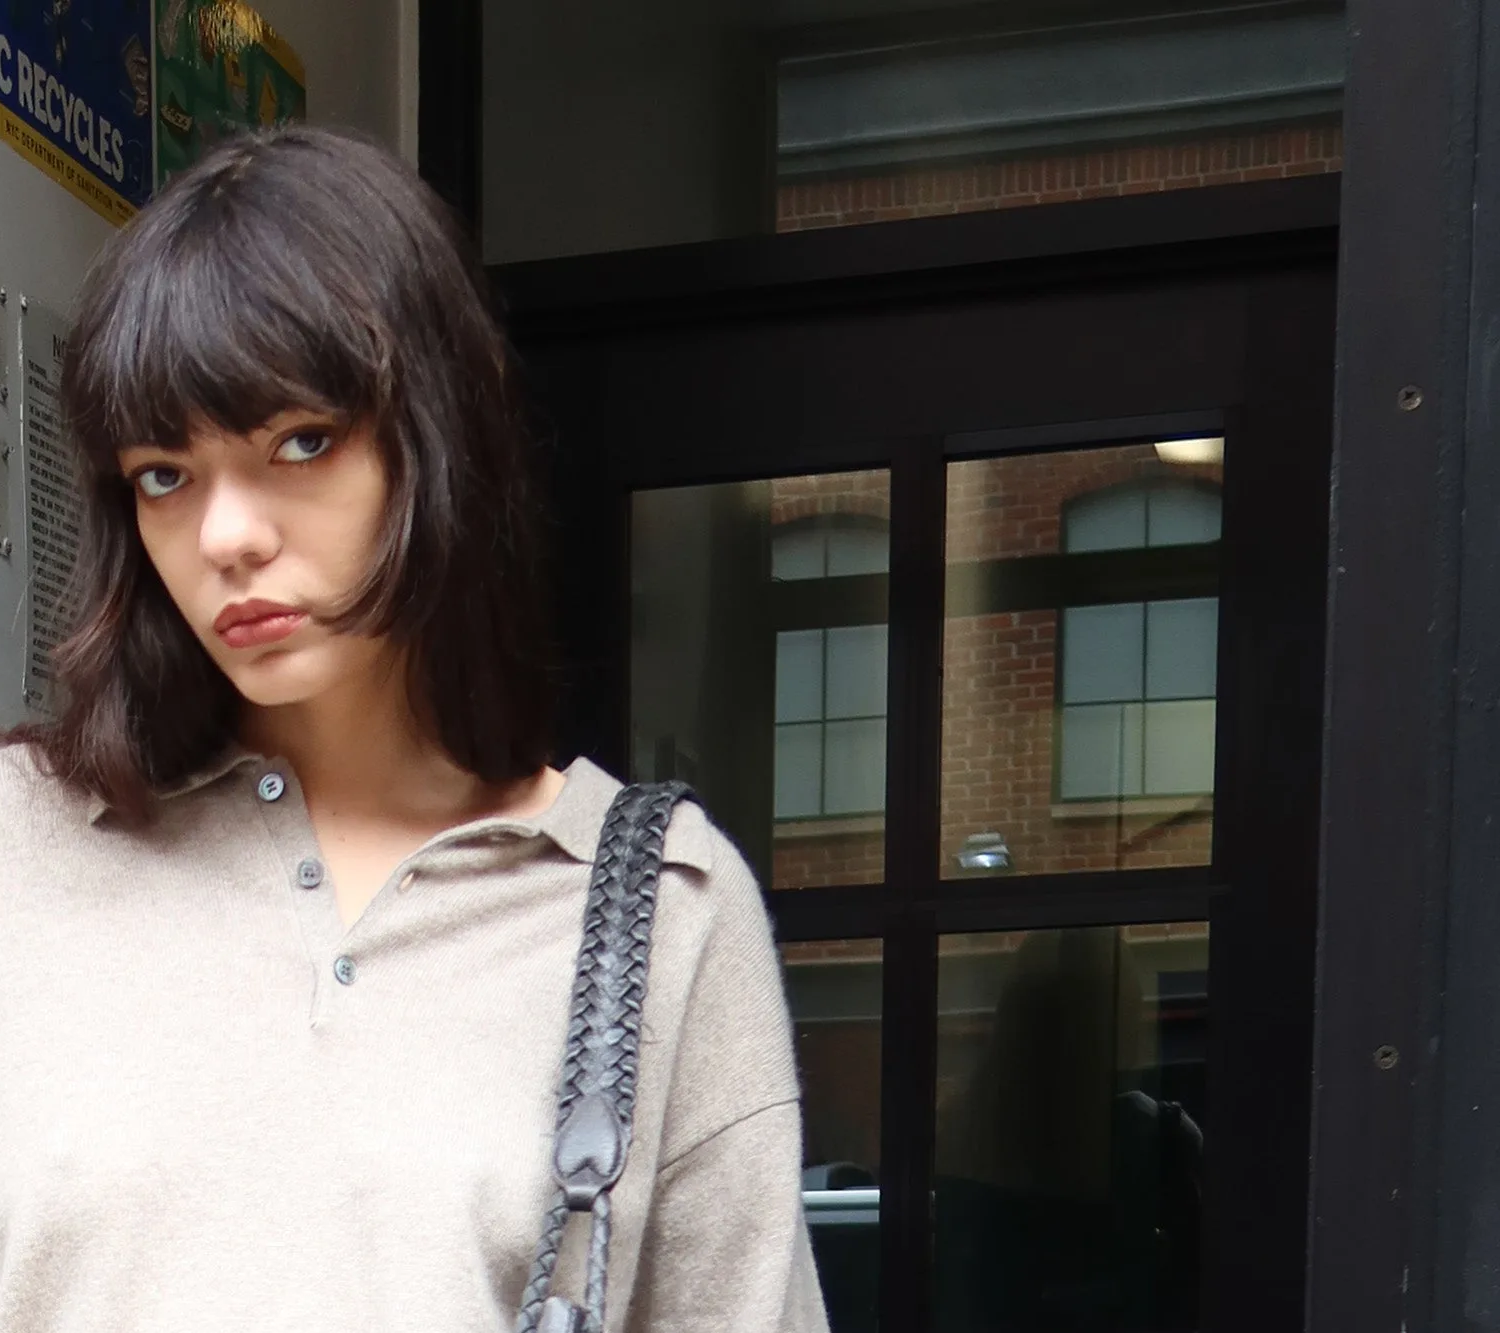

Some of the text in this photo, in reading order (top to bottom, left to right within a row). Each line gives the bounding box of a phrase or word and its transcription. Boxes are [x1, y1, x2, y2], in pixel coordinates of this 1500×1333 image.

[17, 48, 124, 183] RECYCLES
[21, 128, 64, 176] DEPARTMENT
[66, 164, 76, 181] OF
[76, 173, 114, 211] SANITATION
